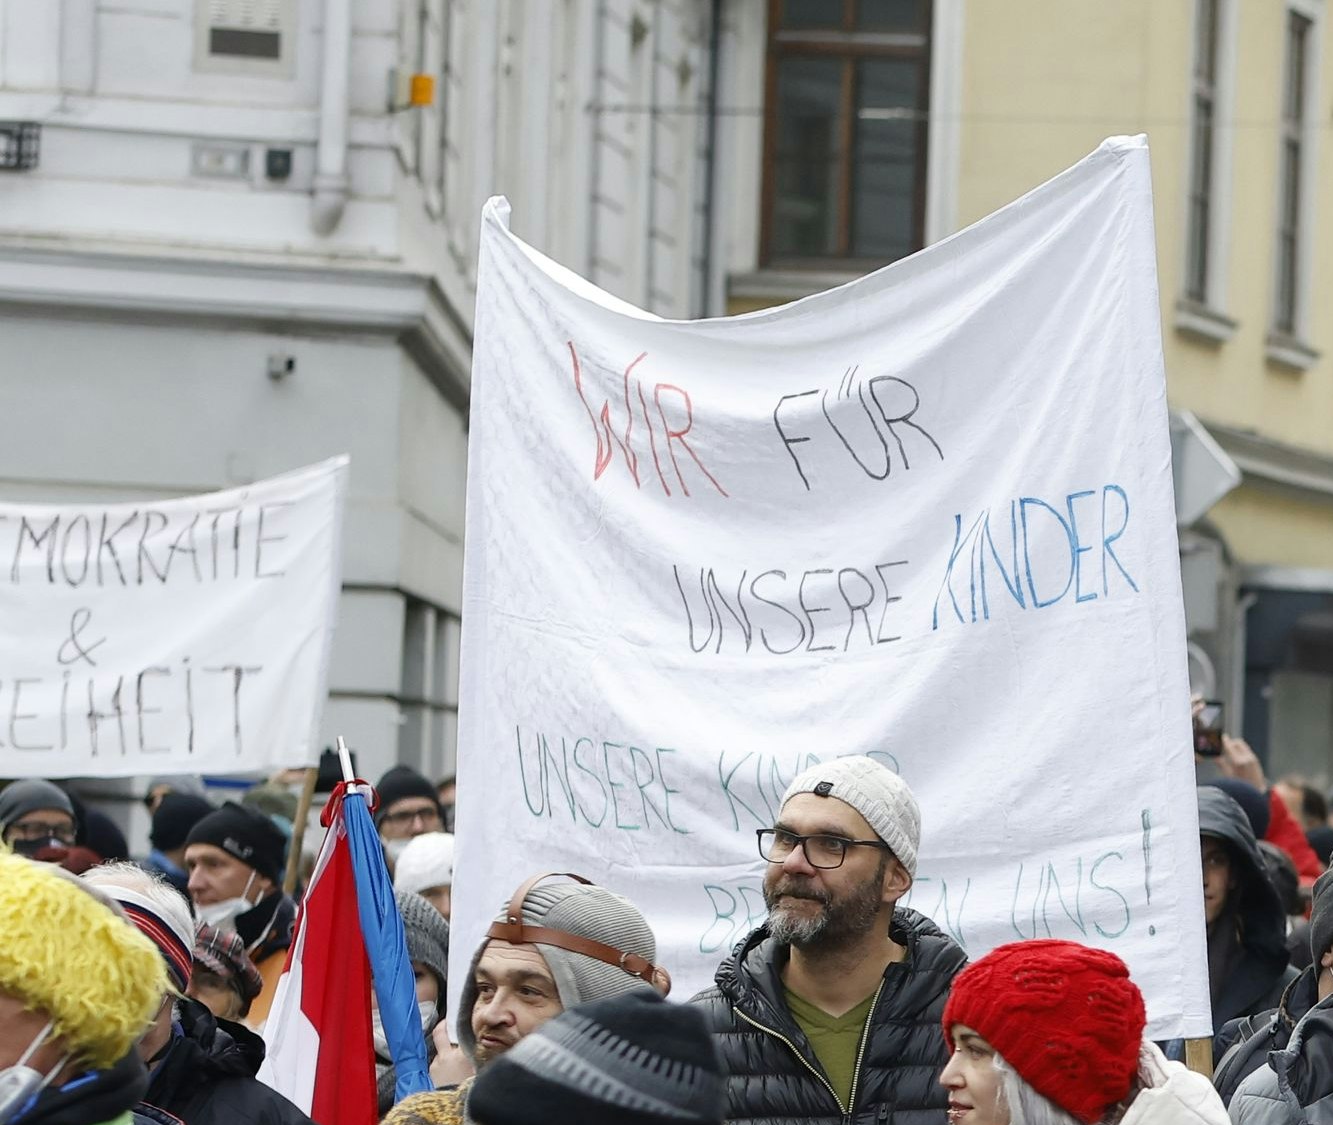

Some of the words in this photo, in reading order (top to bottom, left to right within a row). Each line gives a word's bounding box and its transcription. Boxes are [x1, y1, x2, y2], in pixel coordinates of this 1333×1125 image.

[568, 341, 729, 497] WIR
[774, 365, 944, 491] FÜR
[0, 500, 297, 587] MOKRATIE
[673, 561, 909, 655] UNSERE
[932, 485, 1139, 631] KINDER
[57, 607, 107, 667] &
[515, 725, 694, 834] UNSERE
